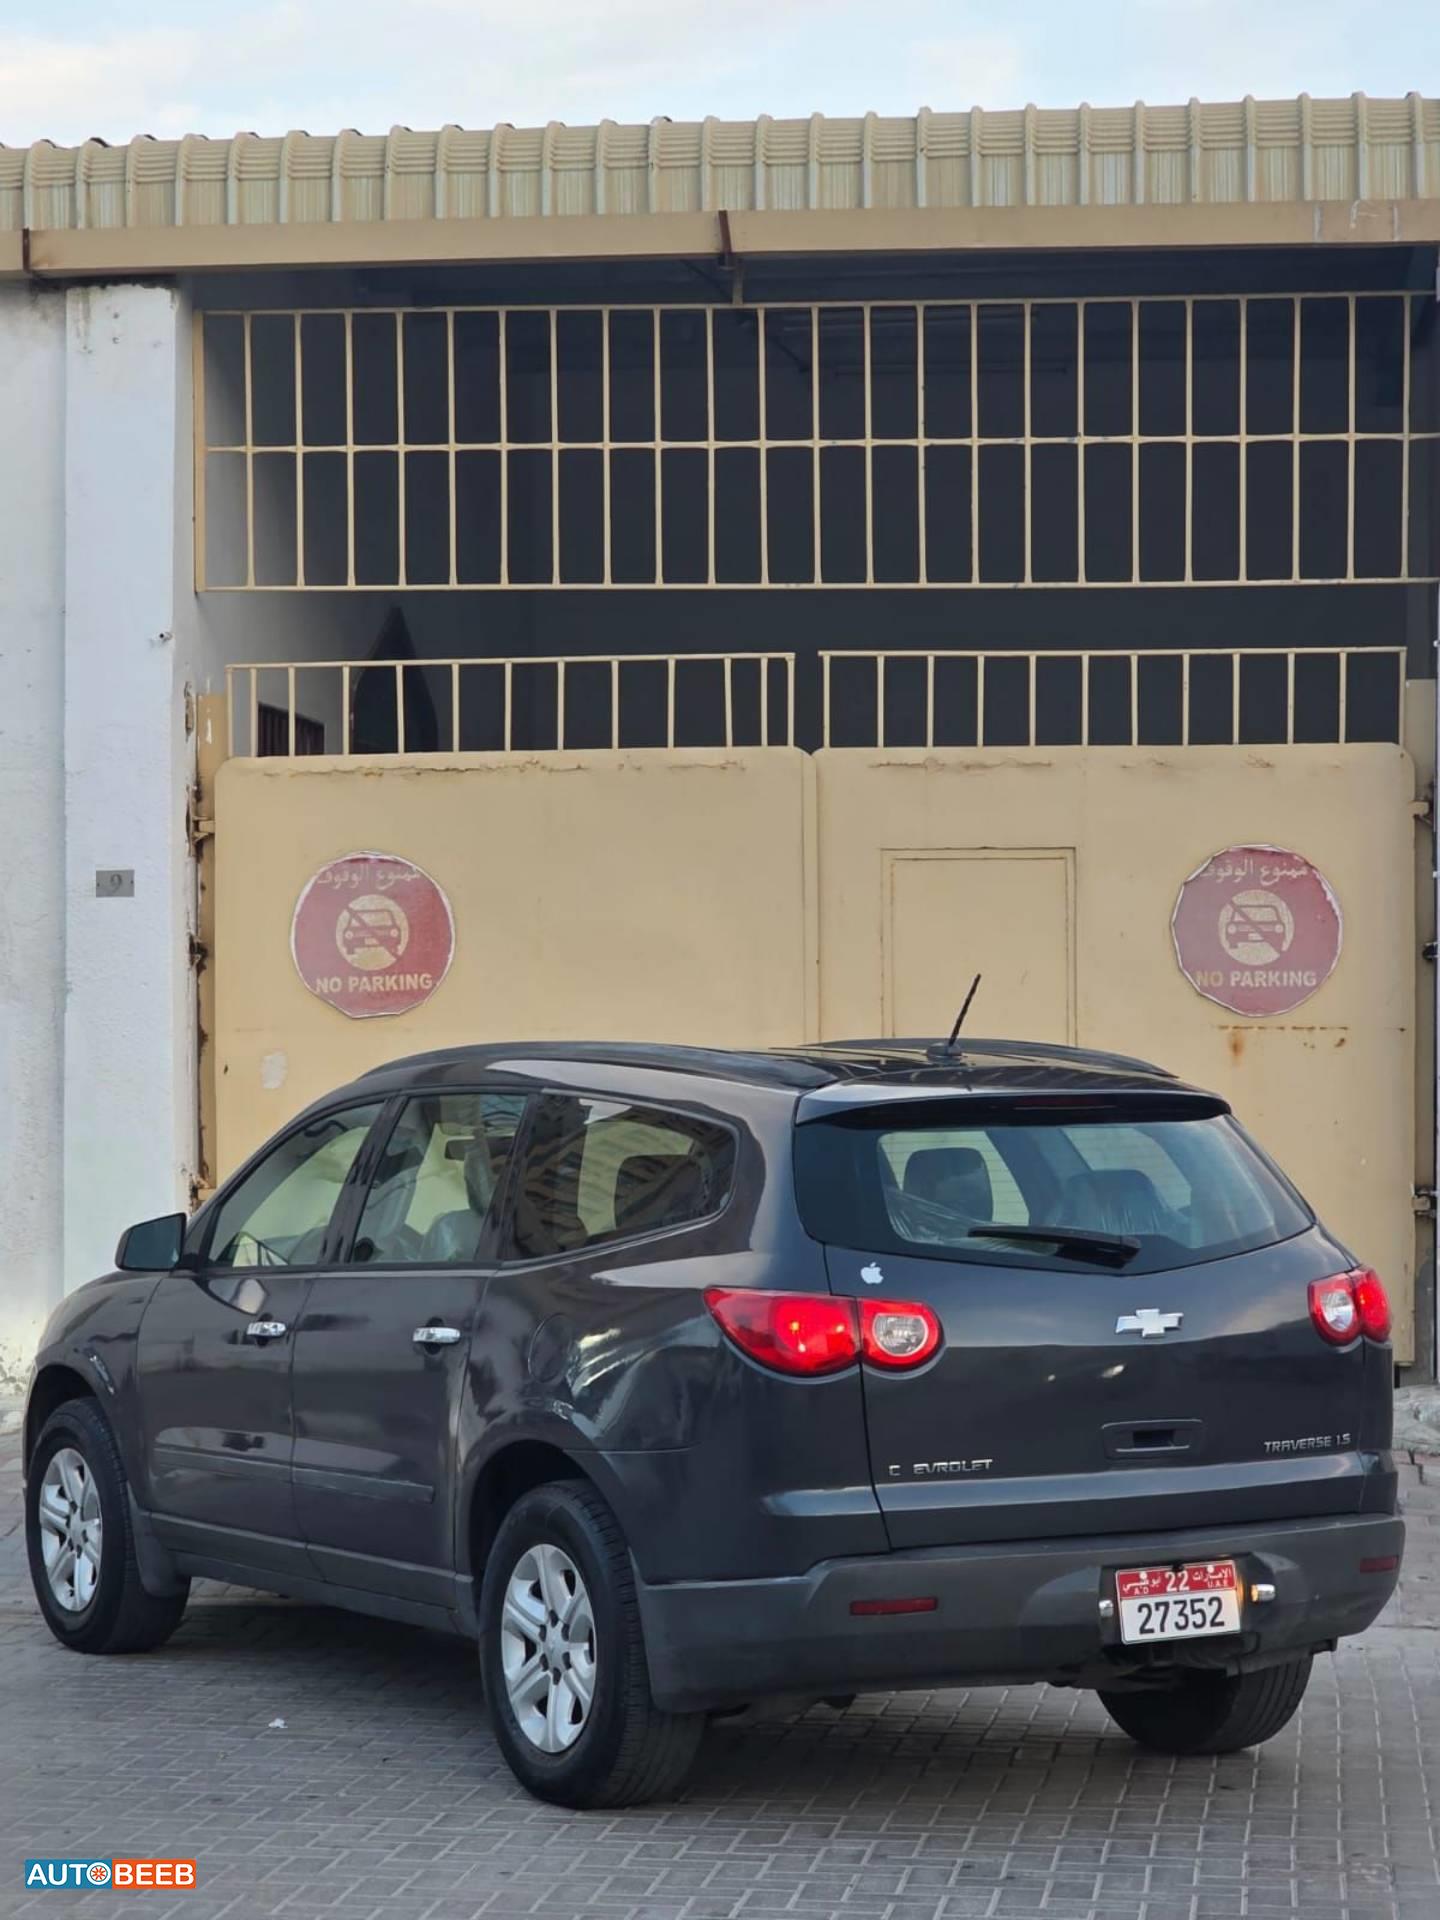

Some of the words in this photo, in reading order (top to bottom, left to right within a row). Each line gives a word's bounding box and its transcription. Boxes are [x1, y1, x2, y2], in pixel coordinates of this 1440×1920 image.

[316, 976, 342, 993] NO
[348, 973, 433, 992] PARKING
[1196, 970, 1224, 987] NO
[1230, 970, 1317, 987] PARKING
[1264, 1435, 1332, 1453] TRAVERSE
[1165, 1570, 1190, 1592] 22
[1137, 1596, 1225, 1635] 27352
